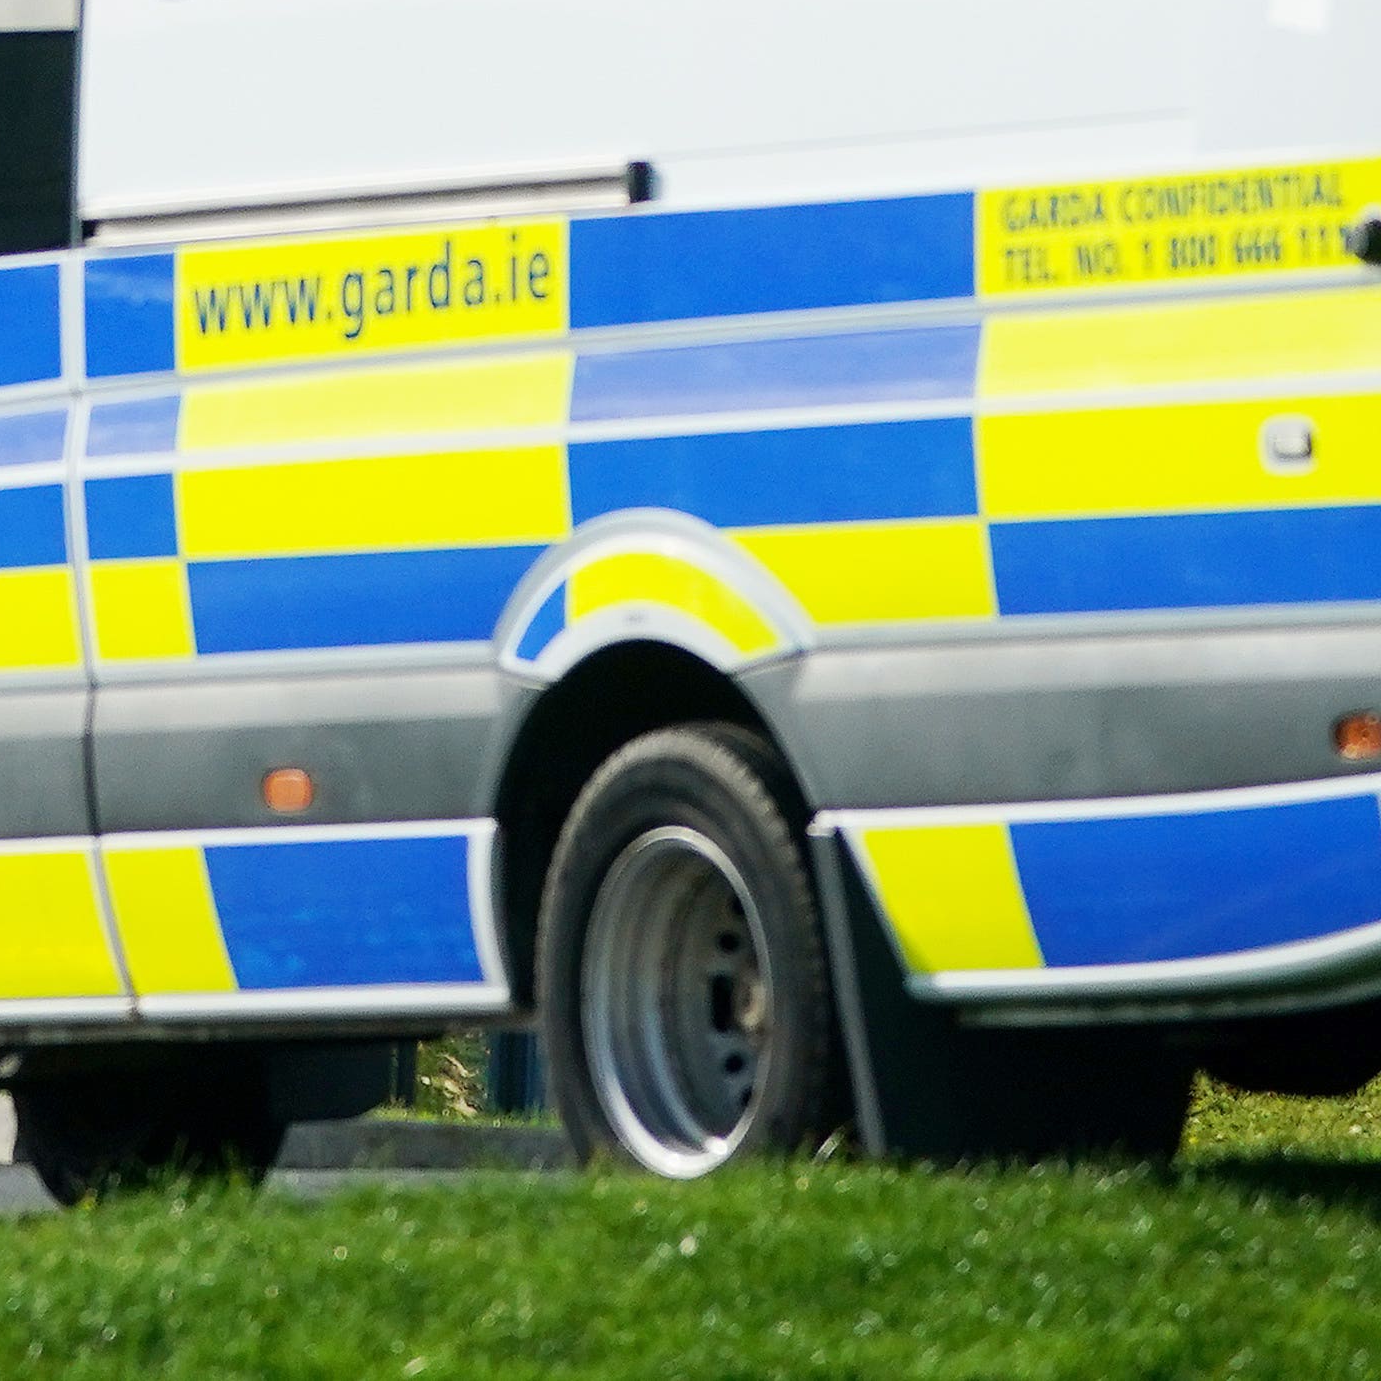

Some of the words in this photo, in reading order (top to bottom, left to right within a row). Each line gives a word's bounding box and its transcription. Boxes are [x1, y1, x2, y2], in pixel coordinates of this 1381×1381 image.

[1002, 191, 1104, 232] GARDA
[1120, 170, 1344, 223] CONFIDENTIAL
[1170, 233, 1217, 268] 800
[1235, 226, 1282, 263] 666
[194, 231, 551, 340] www.garda.ie
